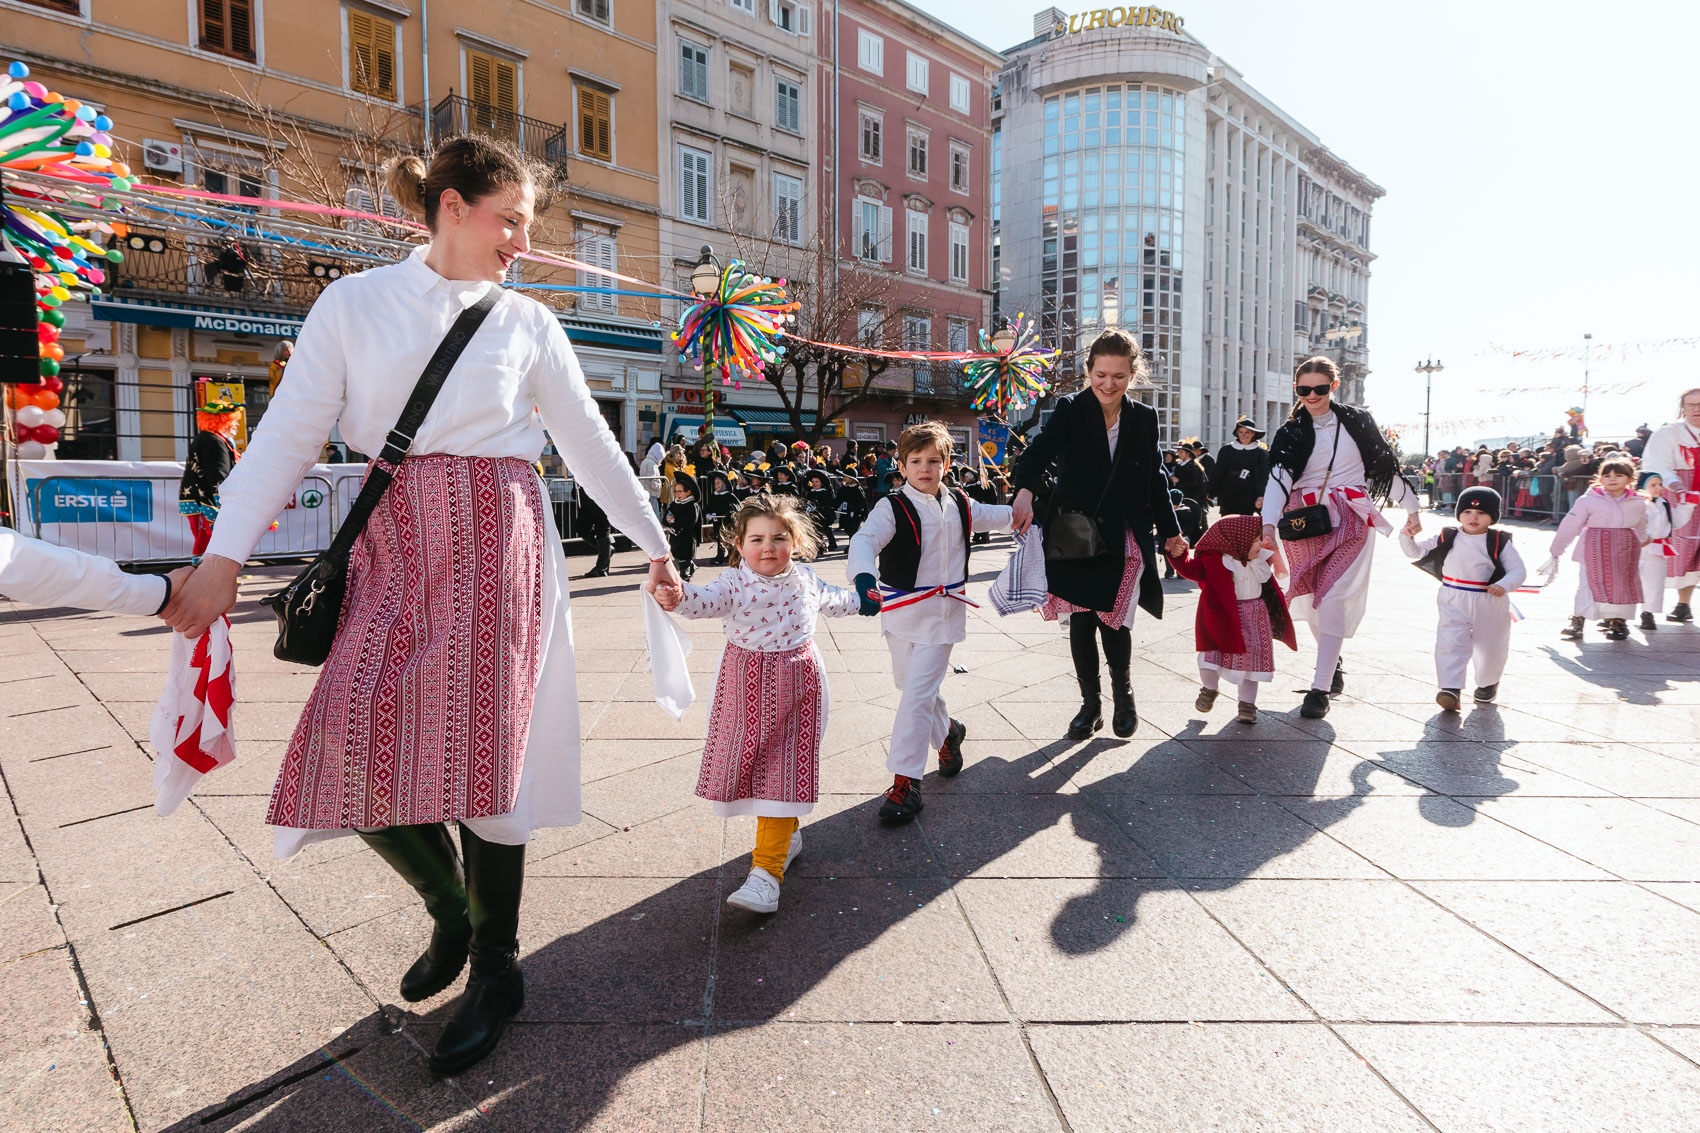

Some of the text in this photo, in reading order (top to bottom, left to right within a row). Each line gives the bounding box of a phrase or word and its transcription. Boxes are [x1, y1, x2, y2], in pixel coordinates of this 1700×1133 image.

[195, 316, 302, 336] McDonald's
[425, 331, 466, 387] VALENTINO
[54, 494, 109, 508] ERSTE
